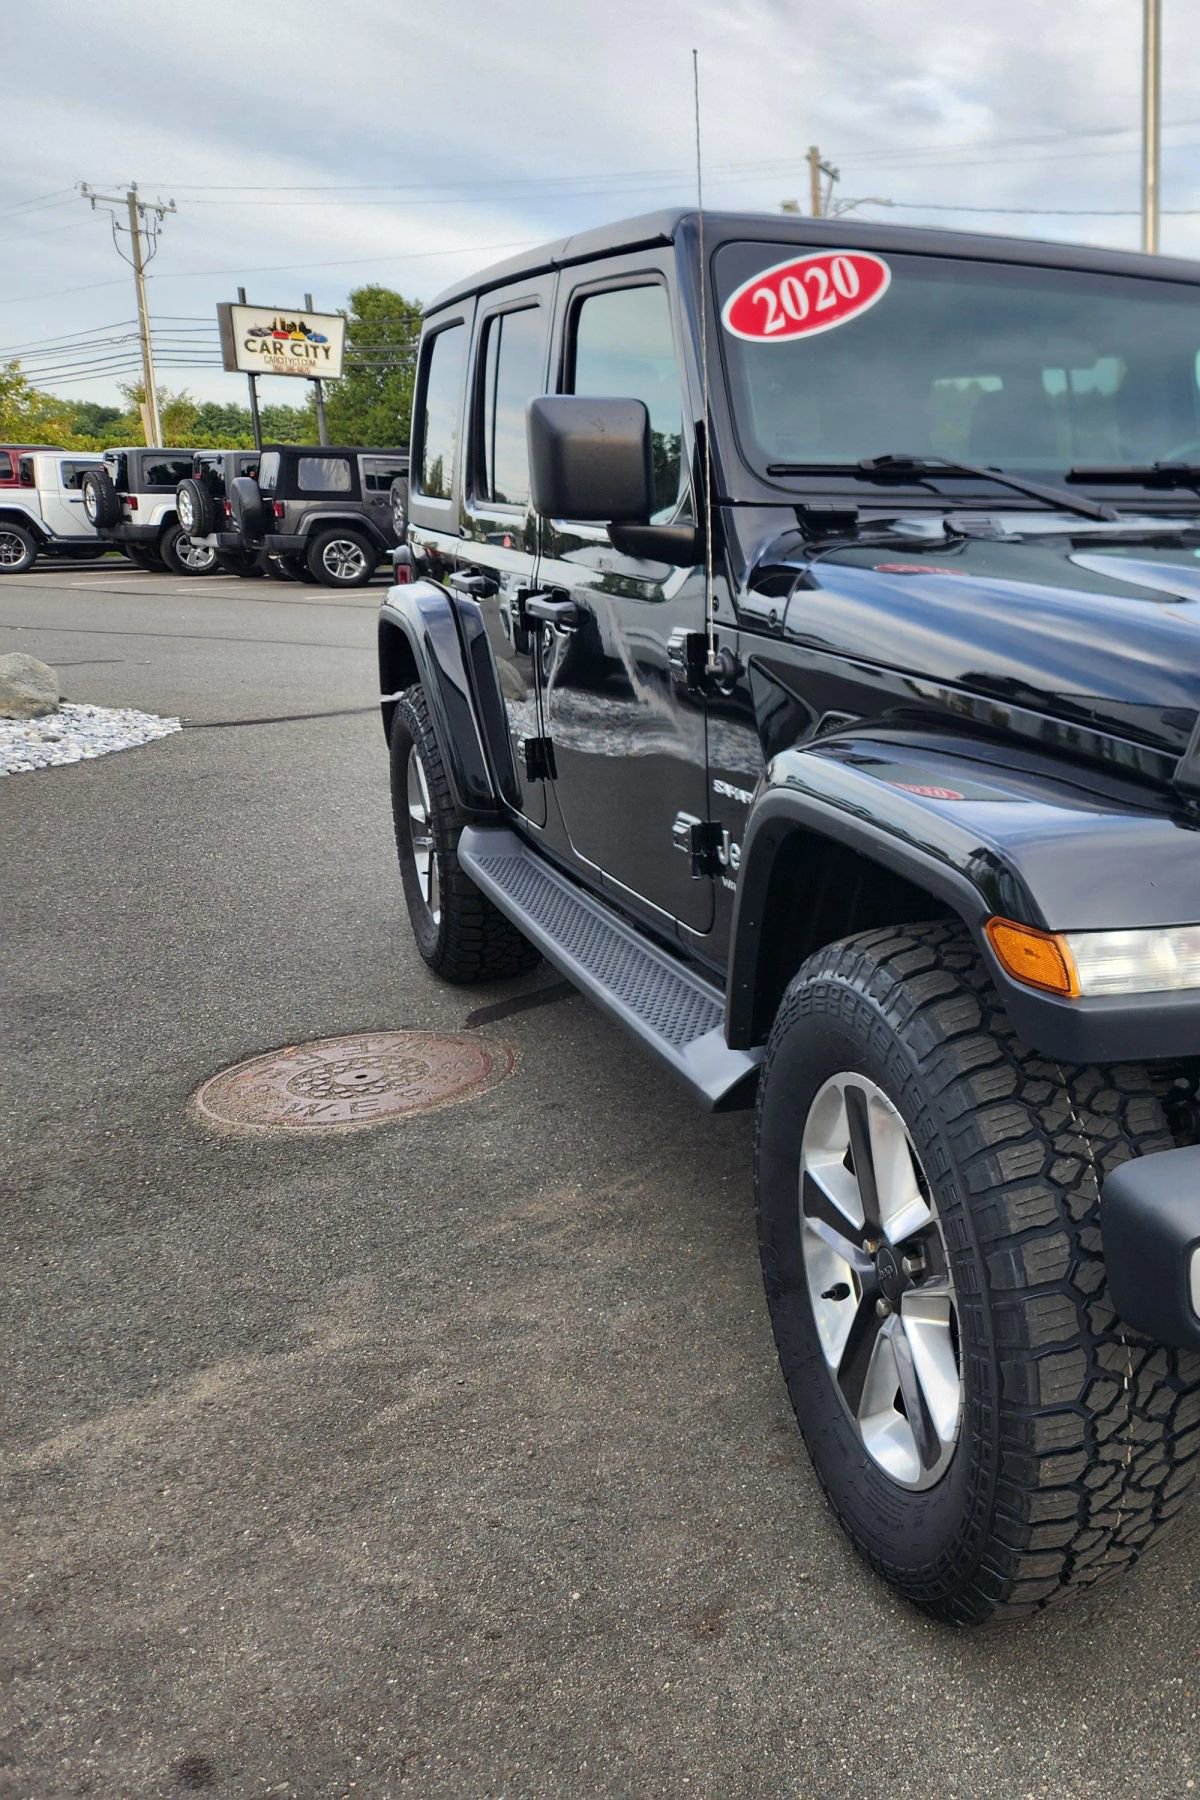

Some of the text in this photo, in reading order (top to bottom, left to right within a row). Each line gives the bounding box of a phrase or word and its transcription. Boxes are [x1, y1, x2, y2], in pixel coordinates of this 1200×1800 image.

[752, 256, 860, 334] 2020
[244, 338, 332, 360] CAR CITY
